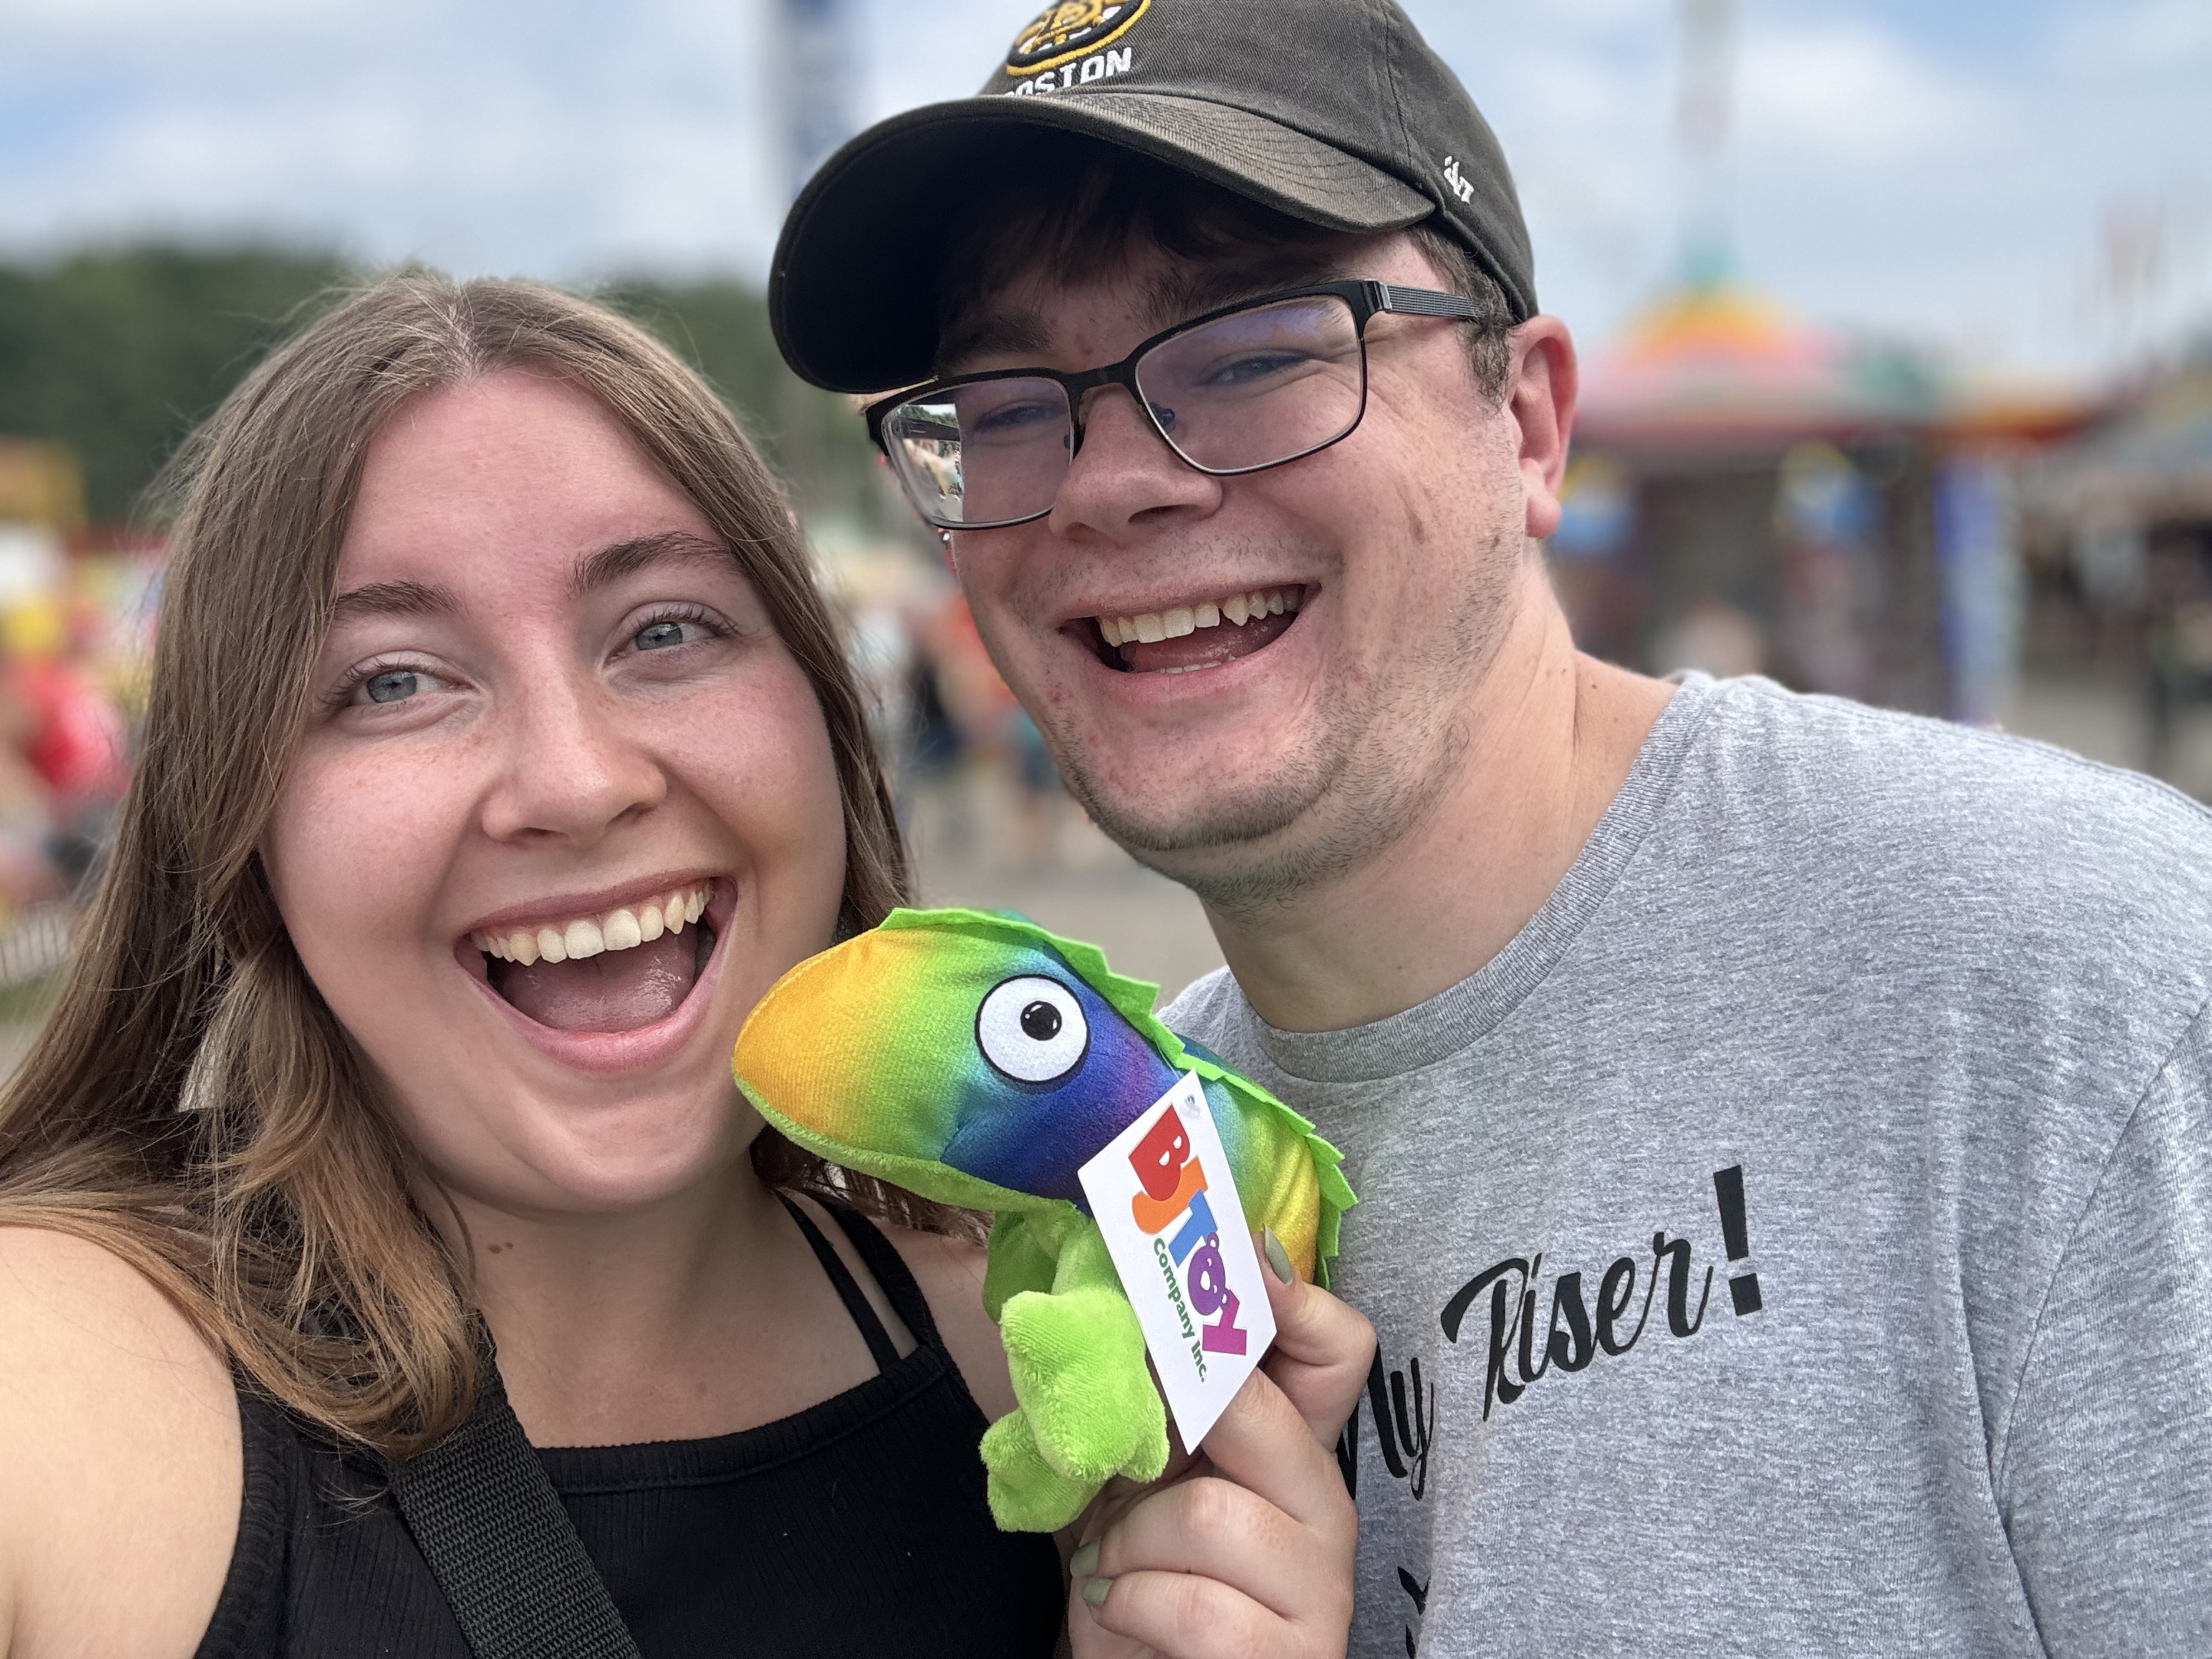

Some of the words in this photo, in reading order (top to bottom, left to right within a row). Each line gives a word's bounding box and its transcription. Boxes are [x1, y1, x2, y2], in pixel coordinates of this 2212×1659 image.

[1004, 47, 1132, 97] OSTON
[1154, 1238, 1196, 1339] Company
[1191, 1340, 1206, 1382] Inc.
[1441, 1165, 1762, 1423] Riser!
